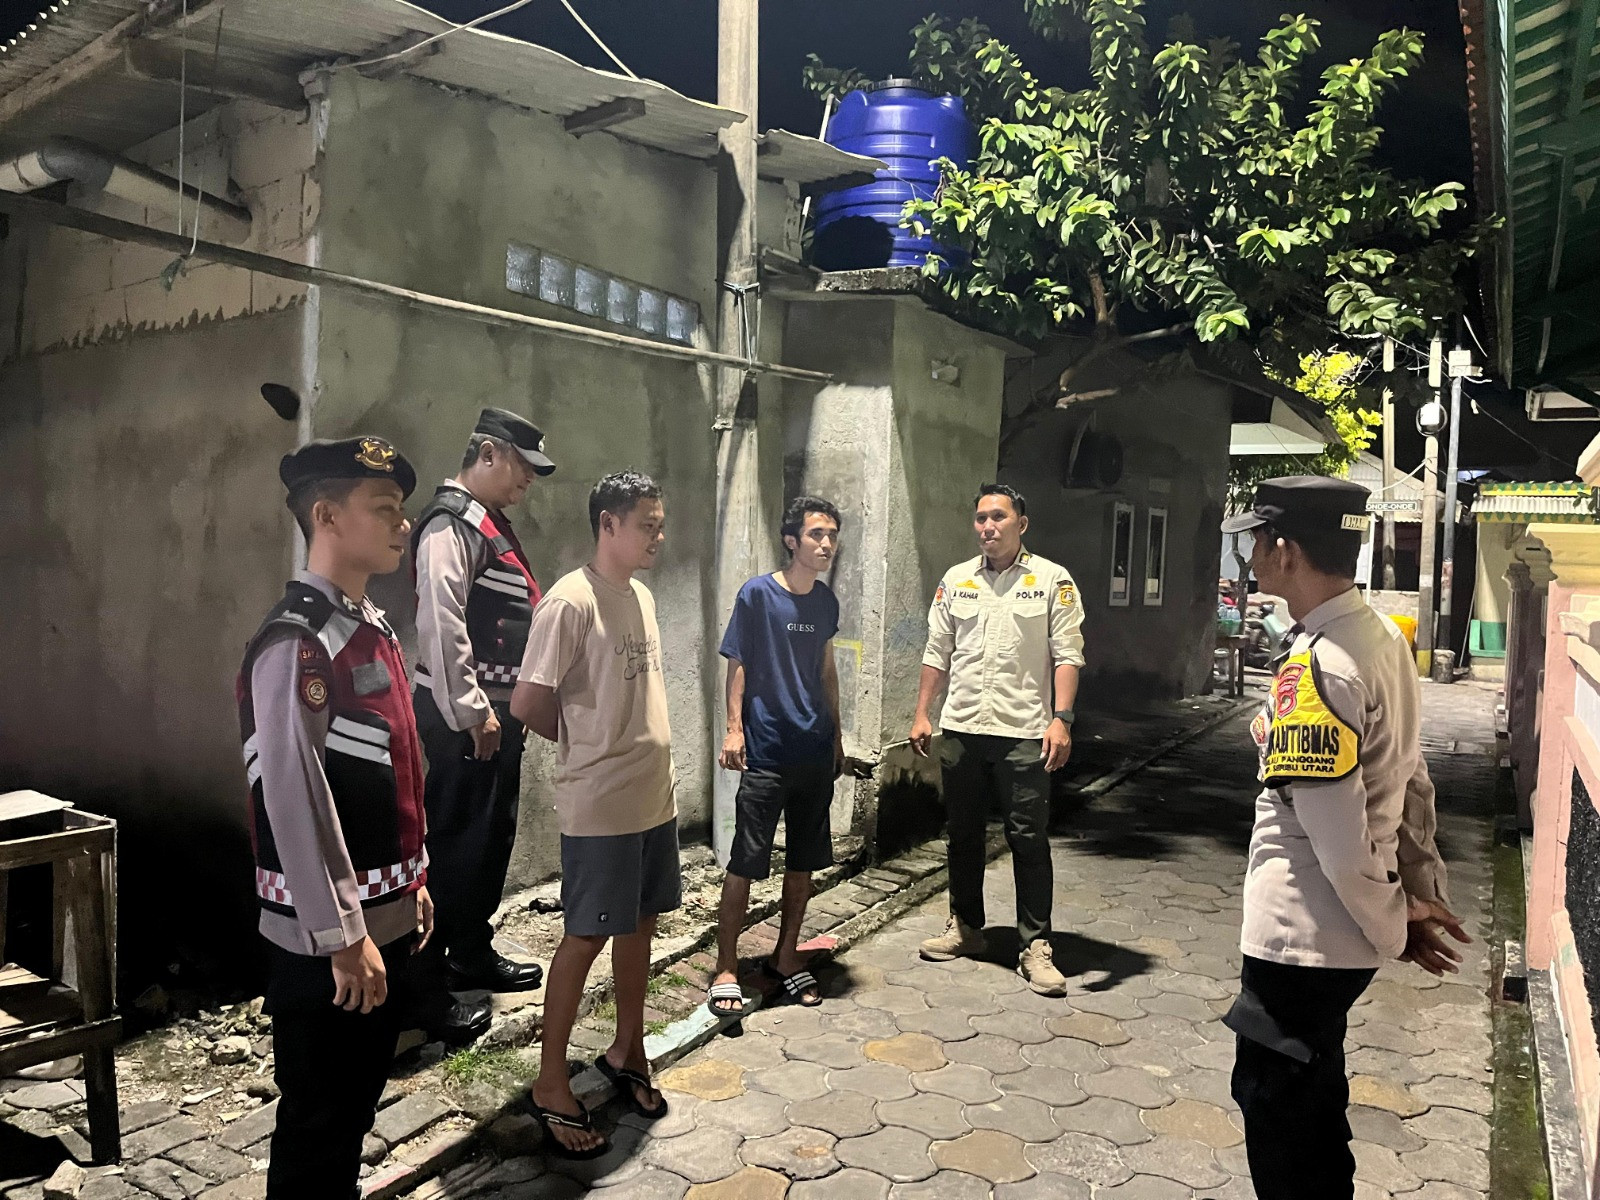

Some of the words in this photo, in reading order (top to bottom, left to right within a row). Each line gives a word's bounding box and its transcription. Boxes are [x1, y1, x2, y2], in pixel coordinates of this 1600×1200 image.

[1016, 591, 1032, 599] POL
[1034, 590, 1045, 599] PP
[787, 622, 815, 633] GUESS
[1281, 756, 1335, 765] PANGGANG
[1302, 764, 1335, 773] UTARA
